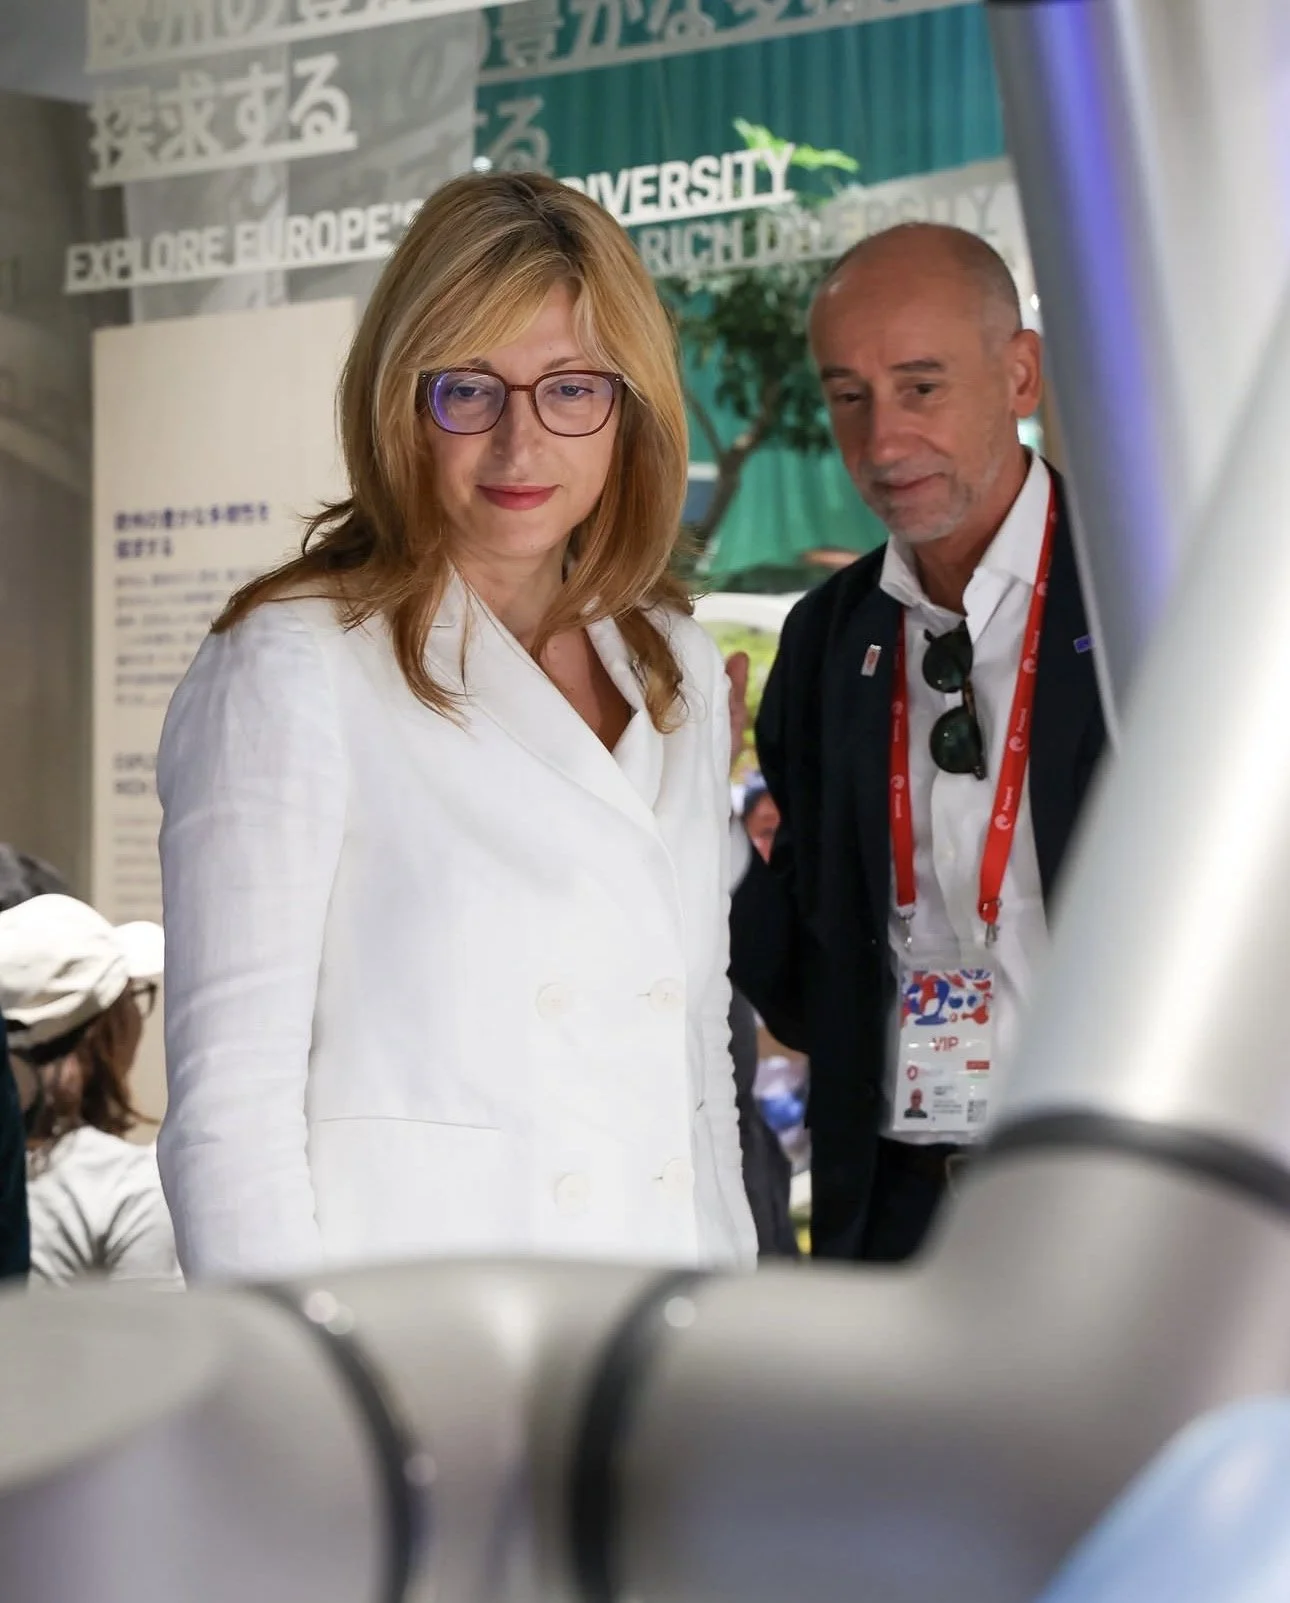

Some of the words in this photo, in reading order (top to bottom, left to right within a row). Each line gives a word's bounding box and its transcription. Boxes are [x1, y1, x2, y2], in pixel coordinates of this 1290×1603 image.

[67, 226, 229, 289] EXPLORE
[641, 214, 743, 274] RICH
[932, 1035, 960, 1052] VIP
